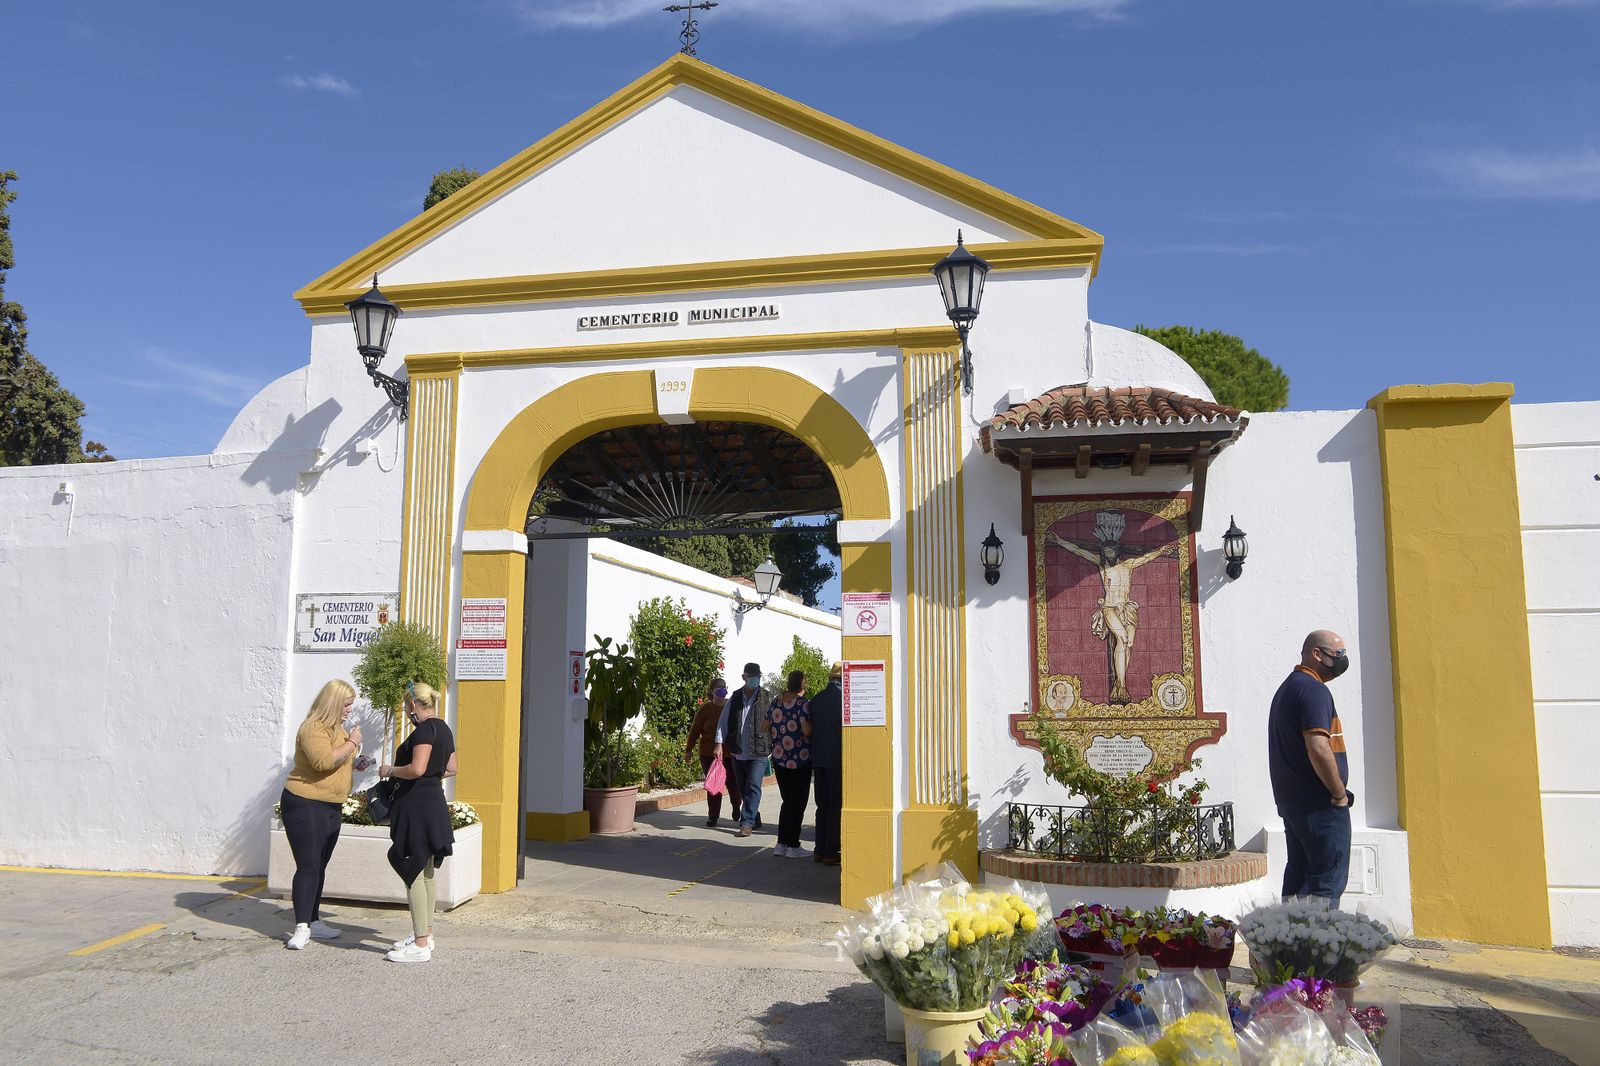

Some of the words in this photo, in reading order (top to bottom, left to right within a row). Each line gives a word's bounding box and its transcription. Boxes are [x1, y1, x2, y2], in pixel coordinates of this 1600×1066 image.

[579, 311, 679, 328] CEMENTERIO
[690, 305, 779, 321] MUNICIPAL
[660, 381, 687, 392] 1999
[322, 602, 374, 613] CEMENTERIO
[325, 614, 369, 625] MUNICIPAL
[313, 627, 336, 643] San
